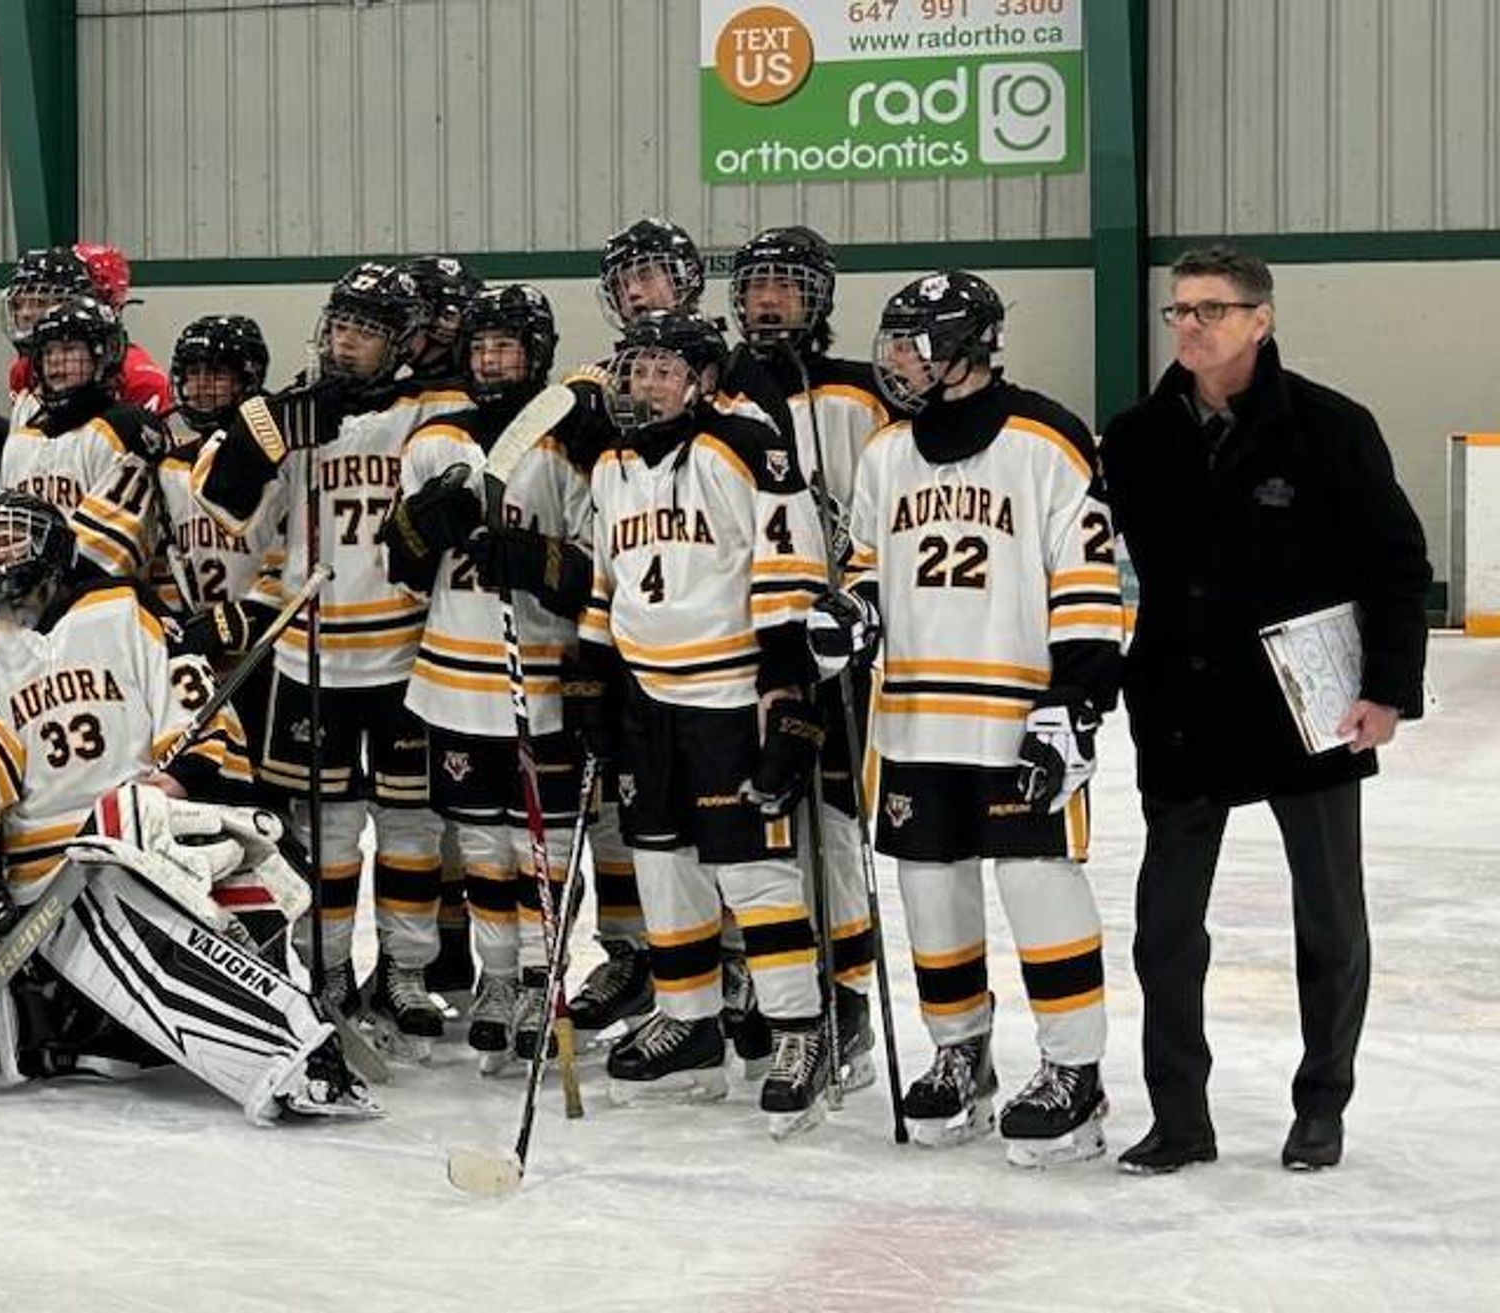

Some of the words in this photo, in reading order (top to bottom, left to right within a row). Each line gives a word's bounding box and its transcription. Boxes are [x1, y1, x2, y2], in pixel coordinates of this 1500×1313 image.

[848, 0, 897, 22] 647
[921, 0, 967, 19] 991
[732, 27, 793, 51] TEXT
[735, 54, 793, 87] US
[848, 66, 967, 127] rad
[715, 137, 968, 173] orthodontics
[106, 465, 149, 515] 11
[322, 454, 402, 492] UROR
[334, 498, 392, 545] 77
[766, 504, 794, 554] 4
[891, 485, 1014, 537] AURORA
[640, 554, 665, 604] 4
[916, 536, 989, 589] 22
[10, 669, 126, 731] AURORA
[40, 713, 105, 769] 33
[187, 926, 278, 998] VAUGHN
